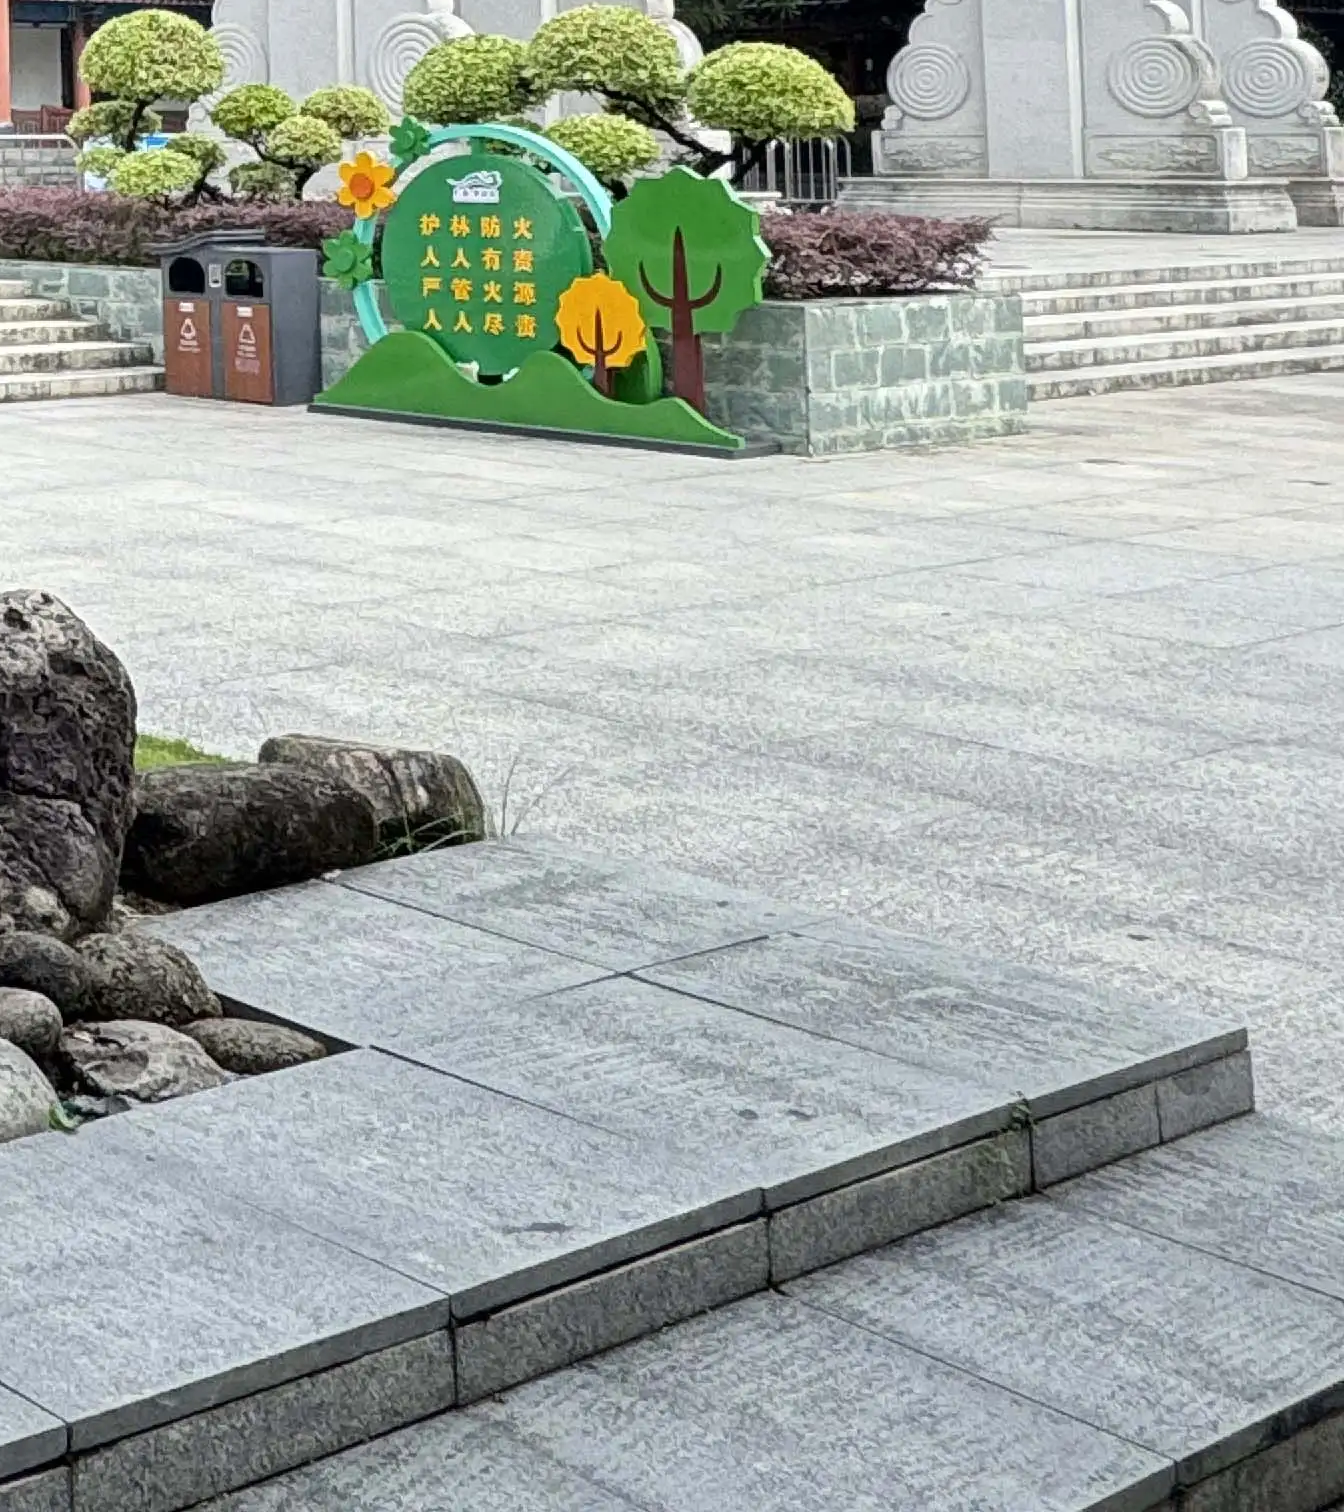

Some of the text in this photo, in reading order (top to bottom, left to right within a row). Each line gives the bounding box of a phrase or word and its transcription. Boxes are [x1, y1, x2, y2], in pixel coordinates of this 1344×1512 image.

[419, 213, 535, 241] 护林防火
[420, 246, 534, 274] 人人有责
[421, 277, 538, 306] 严管火源
[423, 311, 538, 339] 人人尽责
